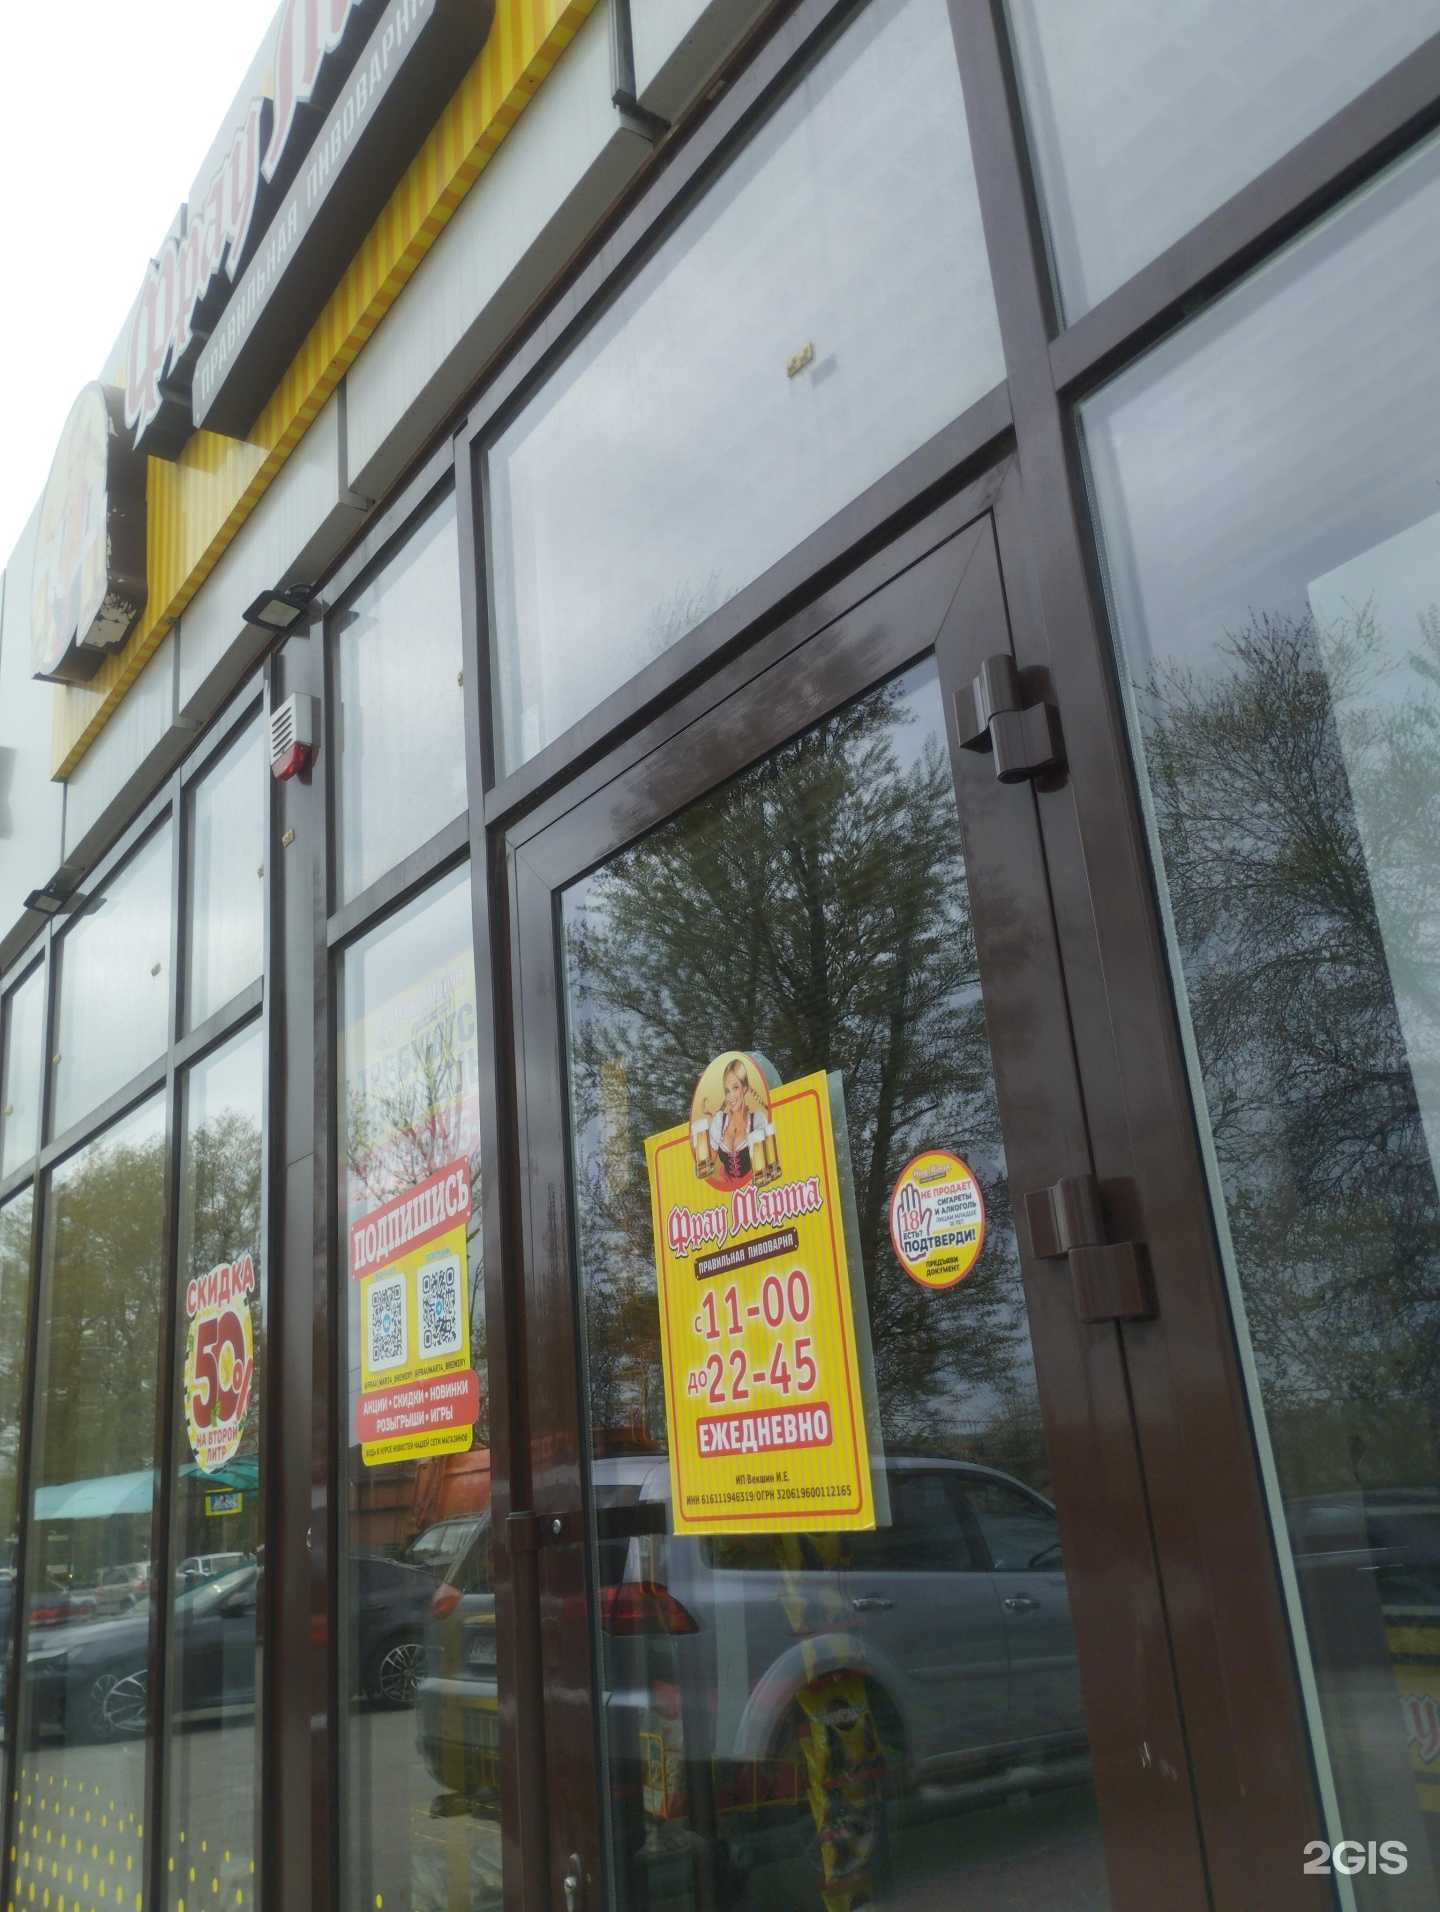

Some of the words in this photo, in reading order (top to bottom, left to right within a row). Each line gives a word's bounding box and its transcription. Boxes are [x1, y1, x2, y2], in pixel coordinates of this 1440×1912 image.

[200, 207, 299, 402] ПРАВИЛЬНАЯ
[921, 1190, 932, 1199] НЕ
[933, 1181, 972, 1197] ПРОДАЕТ
[937, 1192, 972, 1206] СИГАРЕТЫ
[354, 1168, 469, 1270] ПОДПИШИСЬ
[668, 1206, 728, 1258] Фрау
[730, 1176, 823, 1237] Марта
[901, 1209, 920, 1232] 18
[941, 1201, 977, 1215] АЛКОГОЛЬ
[698, 1249, 745, 1276] ПРАВИЛЬНАЯ
[748, 1233, 794, 1262] ПИВОВАРНЯ
[904, 1228, 977, 1253] ПОДТВЕРДИ!
[926, 1264, 960, 1278] ДОКУМЕНТ
[187, 1256, 254, 1316] СКИДКА
[702, 1270, 810, 1340] 11-00
[193, 1311, 253, 1428] 50%
[706, 1338, 816, 1403] 22-45
[363, 1396, 388, 1416] АКЦИИ
[393, 1390, 424, 1409] СКИДКИ
[430, 1380, 469, 1399] НОВИНКИ
[376, 1411, 425, 1433] РОЗЫГРЫШИ
[430, 1405, 453, 1423] ИГРЫ
[699, 1410, 828, 1452] ЕЖЕДНЕВНО
[196, 1433, 206, 1448] НА
[207, 1446, 227, 1462] ЛИТР
[736, 1474, 746, 1485] ИП
[686, 1495, 700, 1505] ИНН
[777, 1484, 852, 1499] 320619600112165
